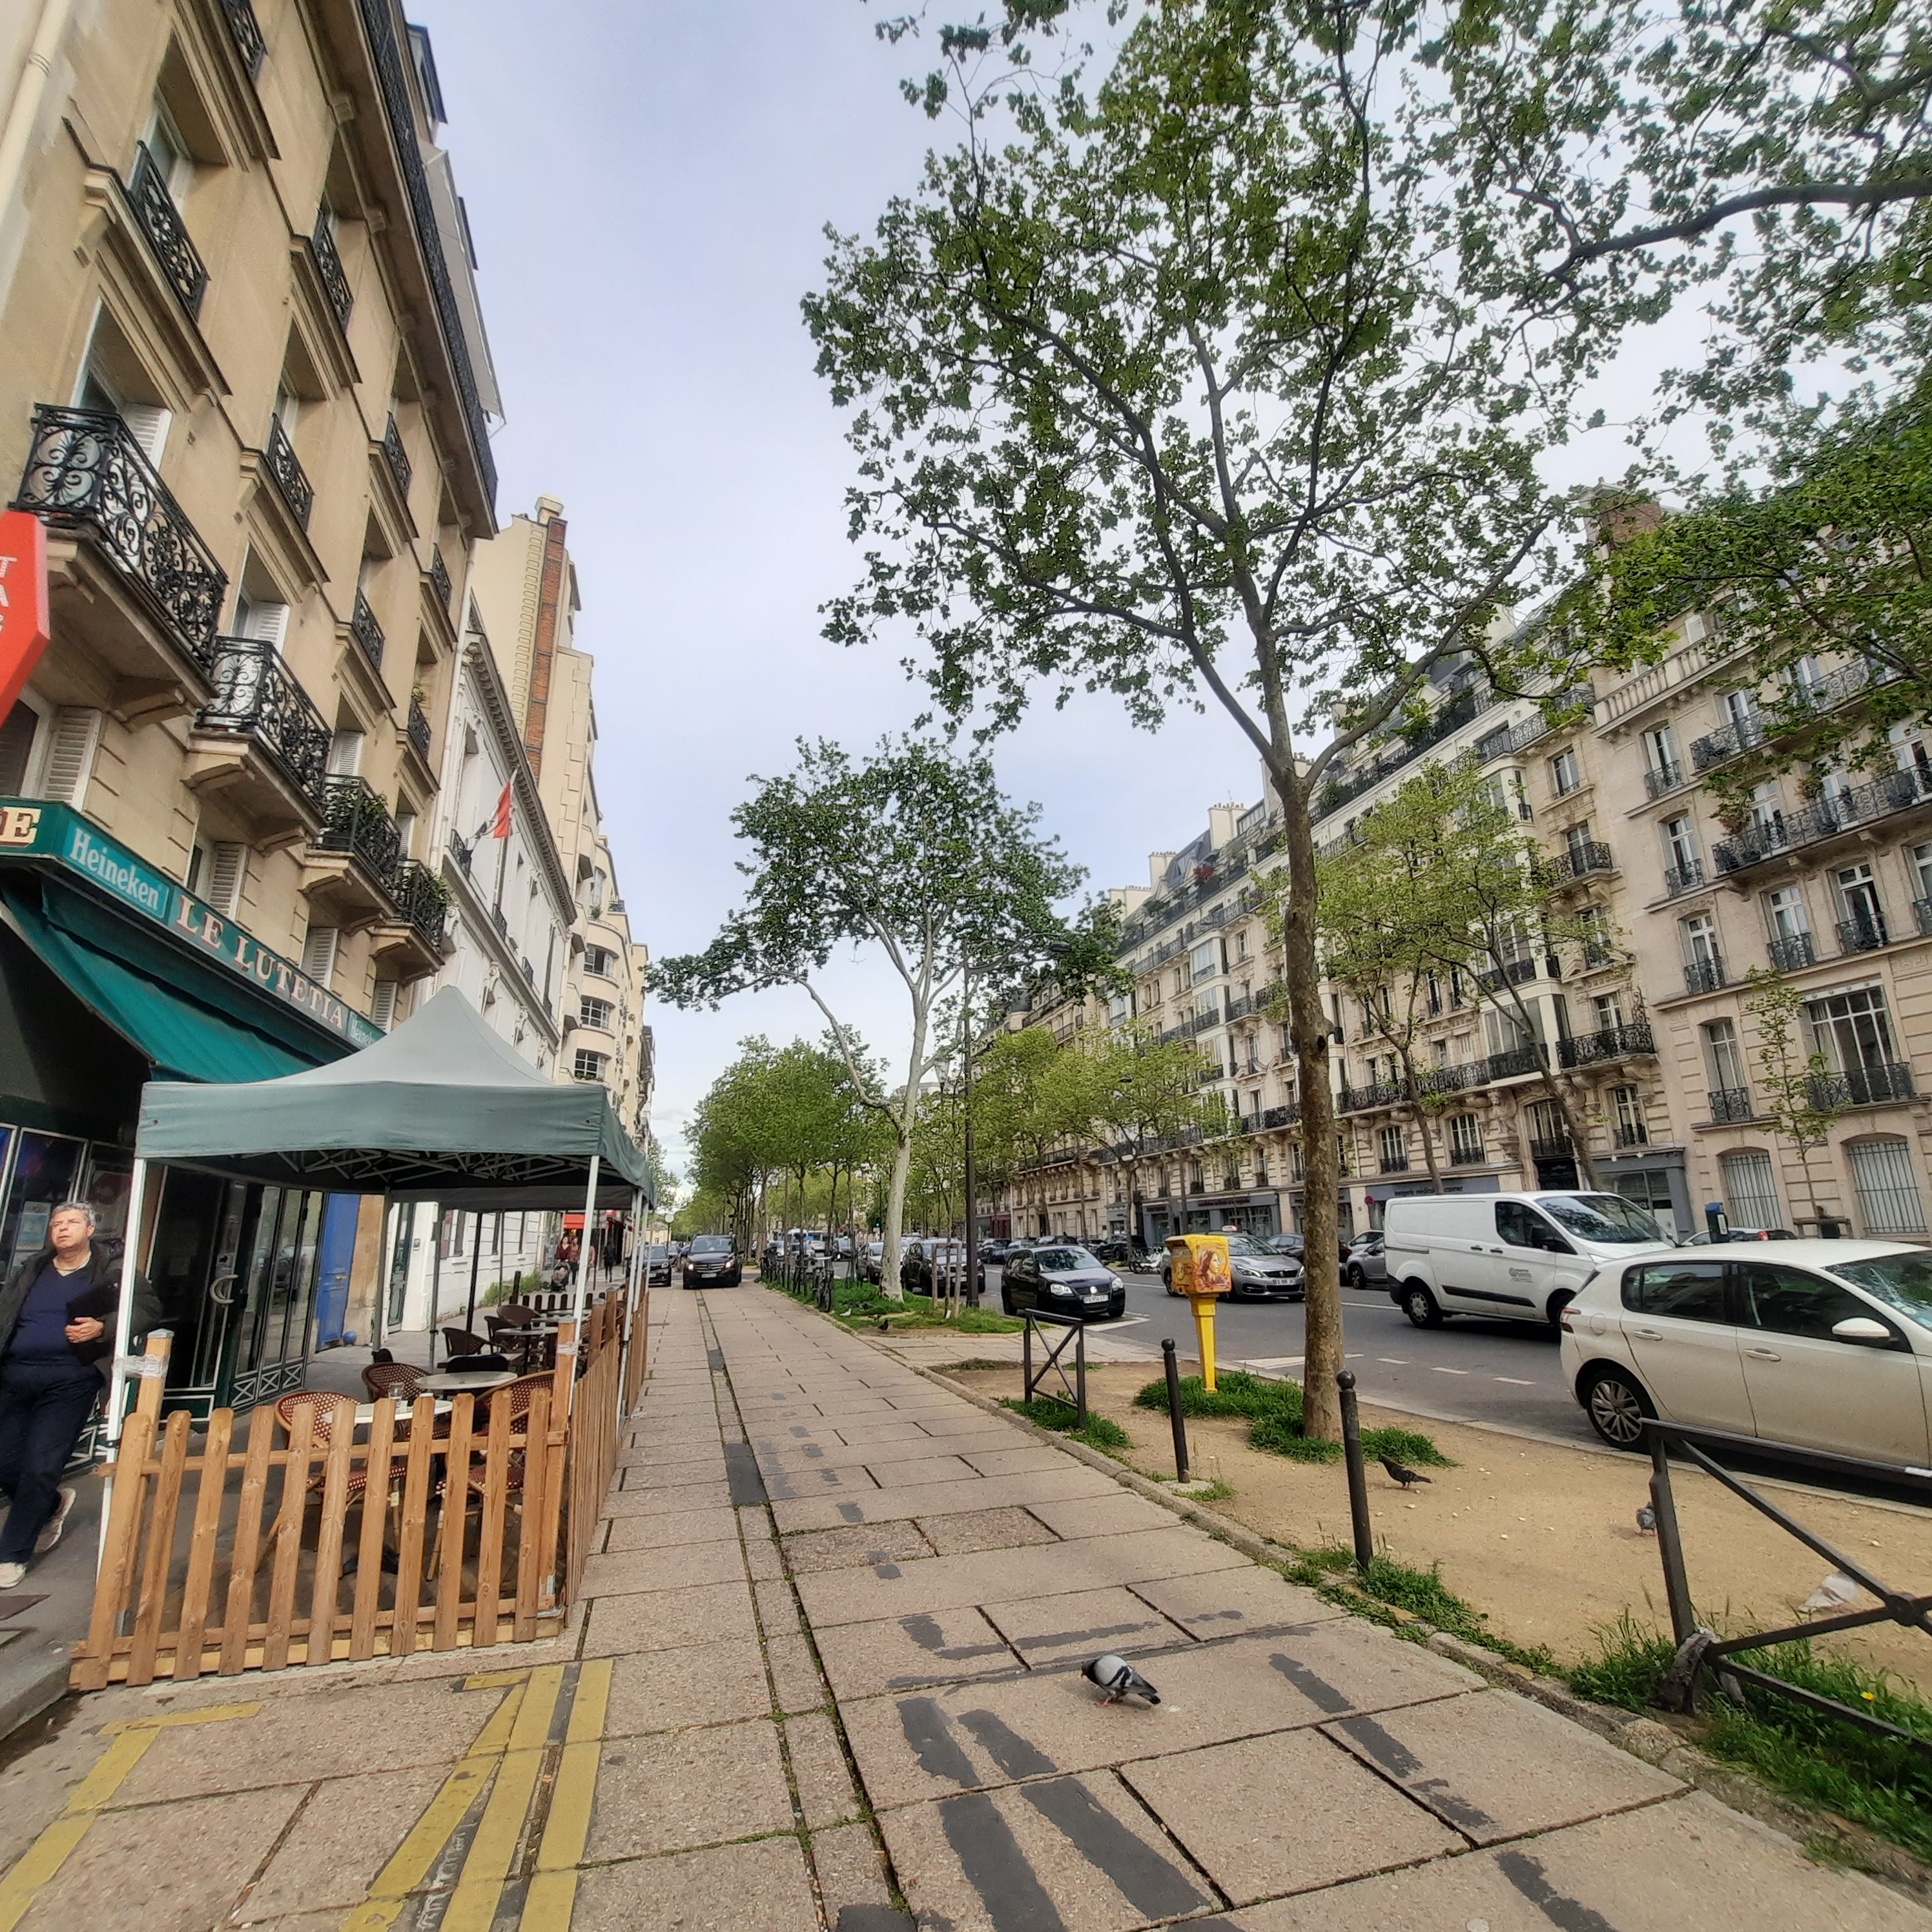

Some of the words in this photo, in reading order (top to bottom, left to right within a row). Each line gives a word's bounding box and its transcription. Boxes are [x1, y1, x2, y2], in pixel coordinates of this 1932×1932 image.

[70, 827, 159, 911] Heineken
[176, 894, 224, 951] LE
[234, 936, 344, 1031] LUTETIA
